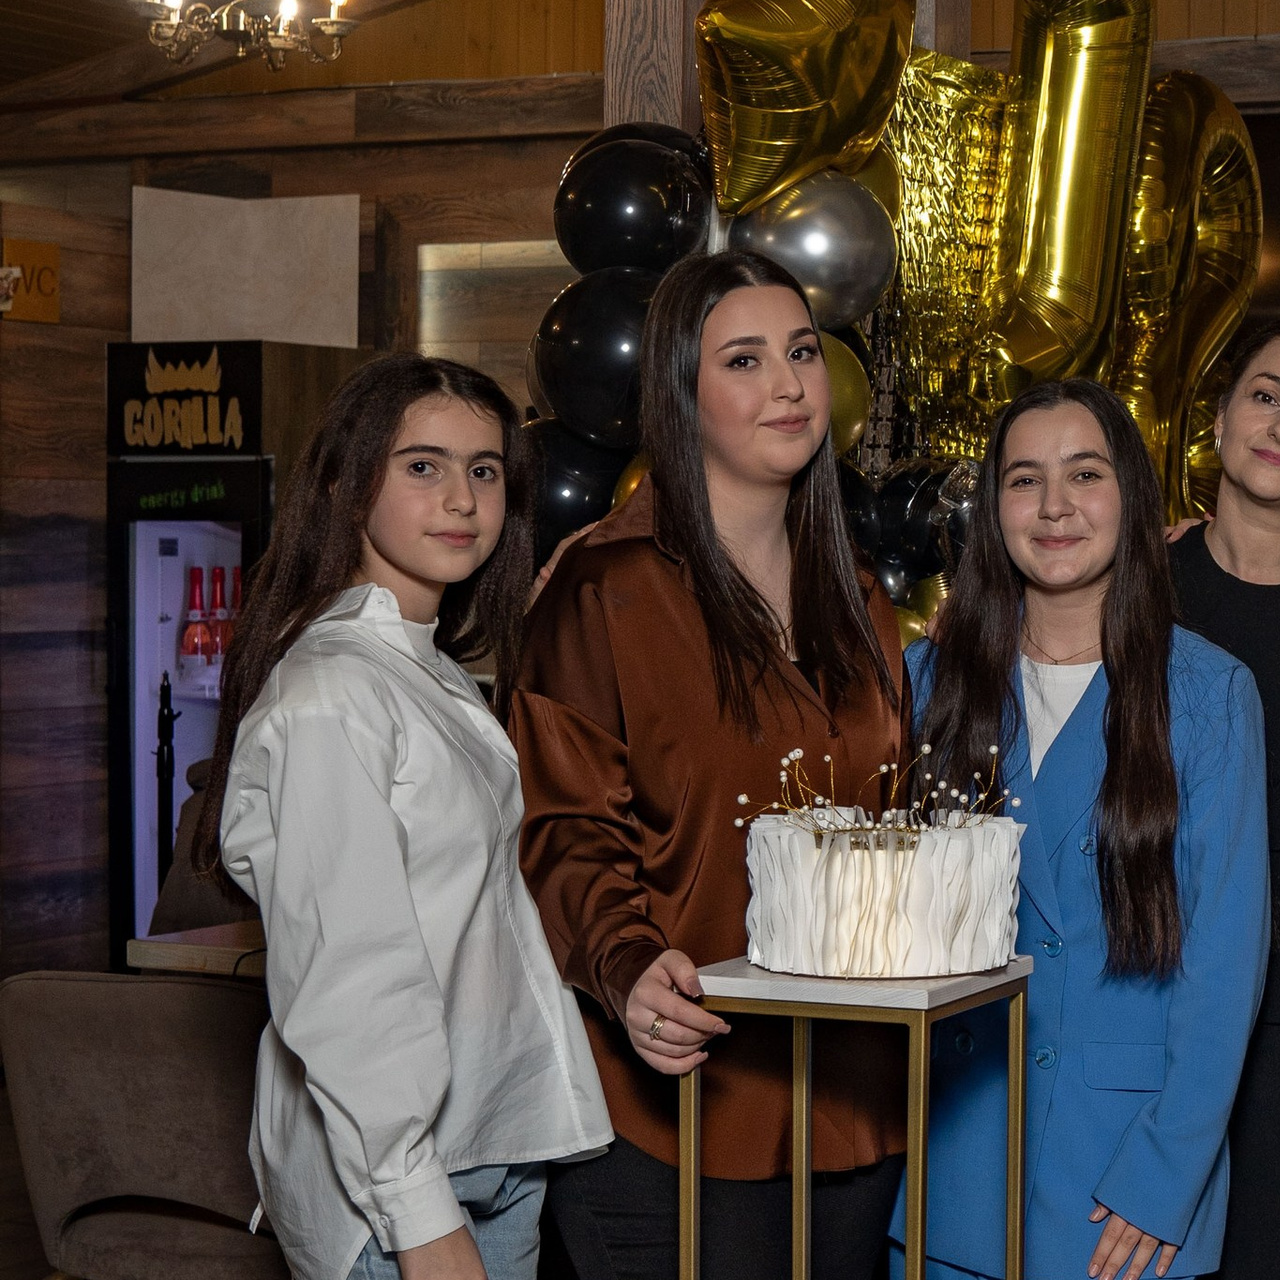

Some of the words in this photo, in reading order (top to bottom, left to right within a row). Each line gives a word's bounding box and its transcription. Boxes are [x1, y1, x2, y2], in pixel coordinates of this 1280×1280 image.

[124, 394, 244, 450] GORILLA
[138, 489, 187, 509] energy
[190, 477, 227, 504] drink
